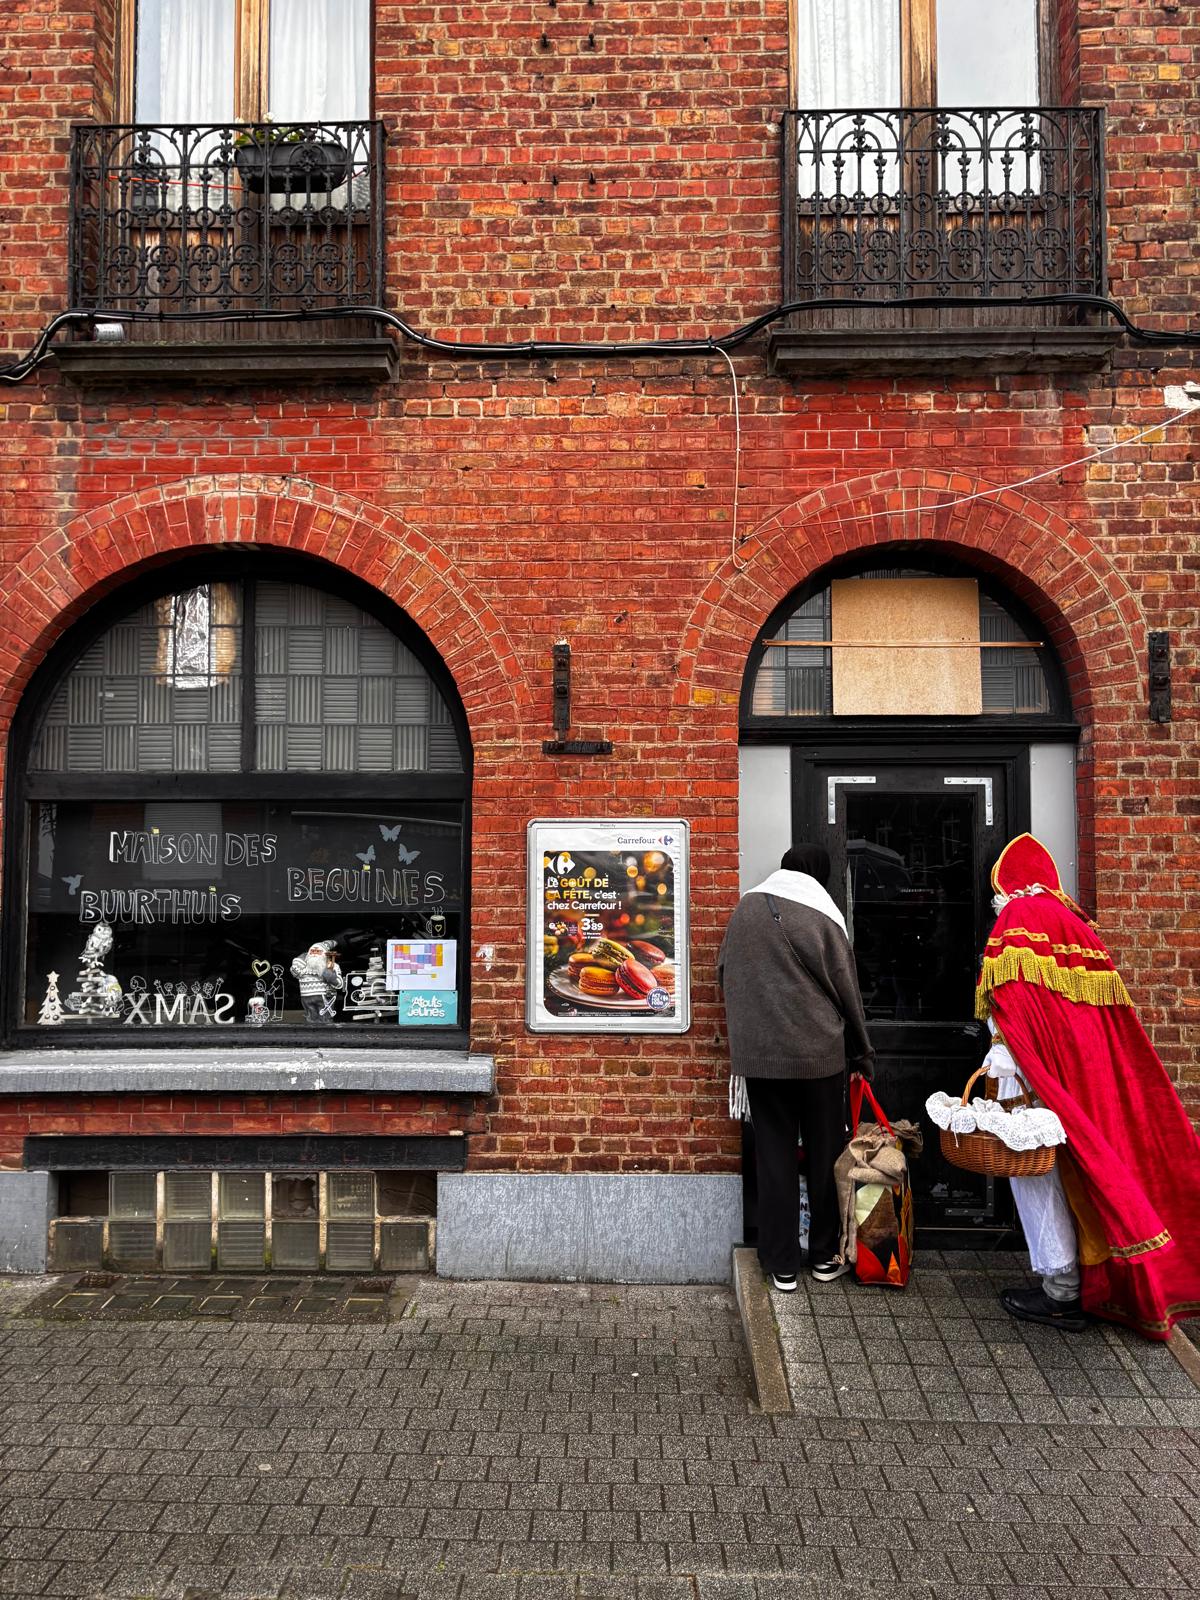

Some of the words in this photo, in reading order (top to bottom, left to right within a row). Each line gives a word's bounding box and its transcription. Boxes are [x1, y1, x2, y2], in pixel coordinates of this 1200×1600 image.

[224, 832, 278, 867] DES
[617, 836, 656, 845] Carrefour
[547, 901, 570, 910] chez
[571, 901, 617, 910] Carrefour
[122, 993, 236, 1025] XMAS
